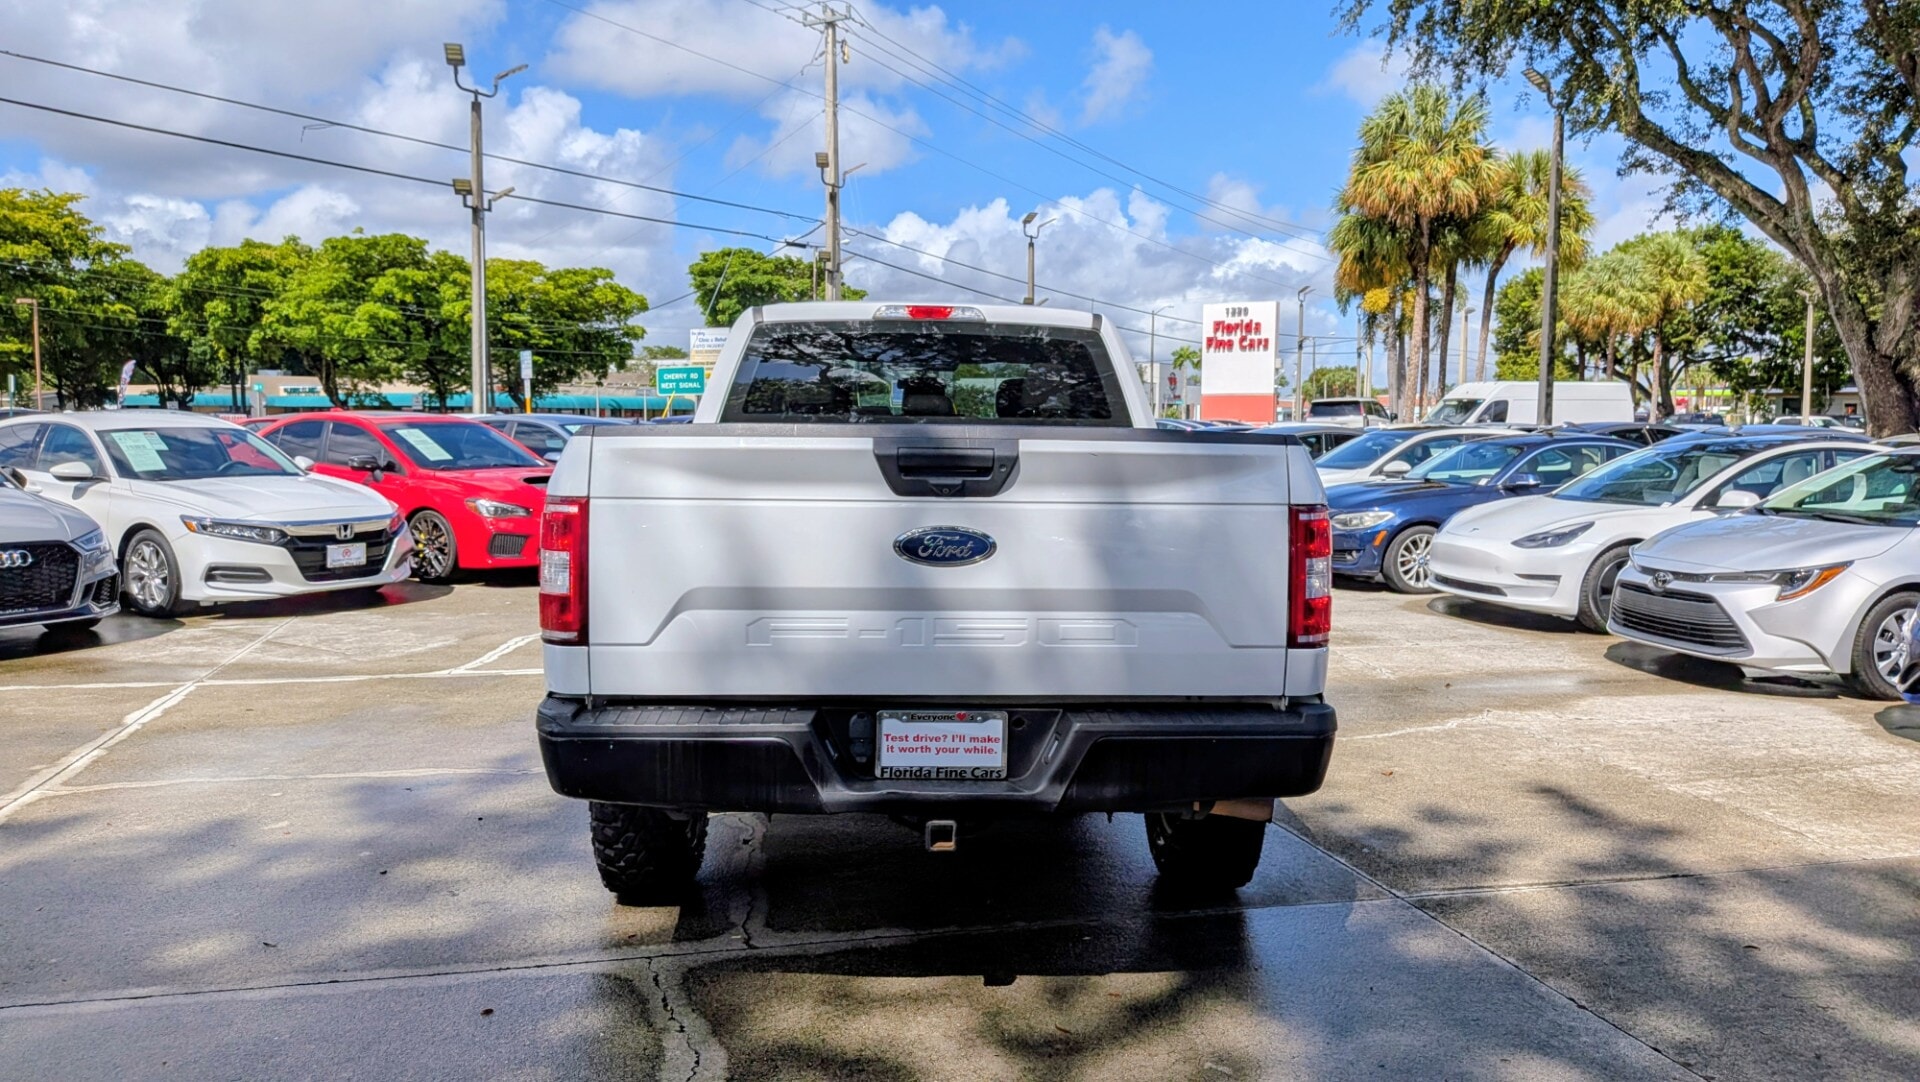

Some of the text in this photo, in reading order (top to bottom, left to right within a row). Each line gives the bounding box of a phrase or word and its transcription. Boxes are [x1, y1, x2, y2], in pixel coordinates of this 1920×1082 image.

[1213, 319, 1262, 337] Florida
[1206, 335, 1269, 353] Fine Cars
[918, 534, 975, 558] Ford
[745, 616, 1139, 647] F-150
[910, 713, 956, 722] Everyone
[884, 733, 1001, 744] Test drive? I'll make
[886, 744, 998, 756] it worth your while.
[880, 767, 1002, 779] Florida Fine Cars
